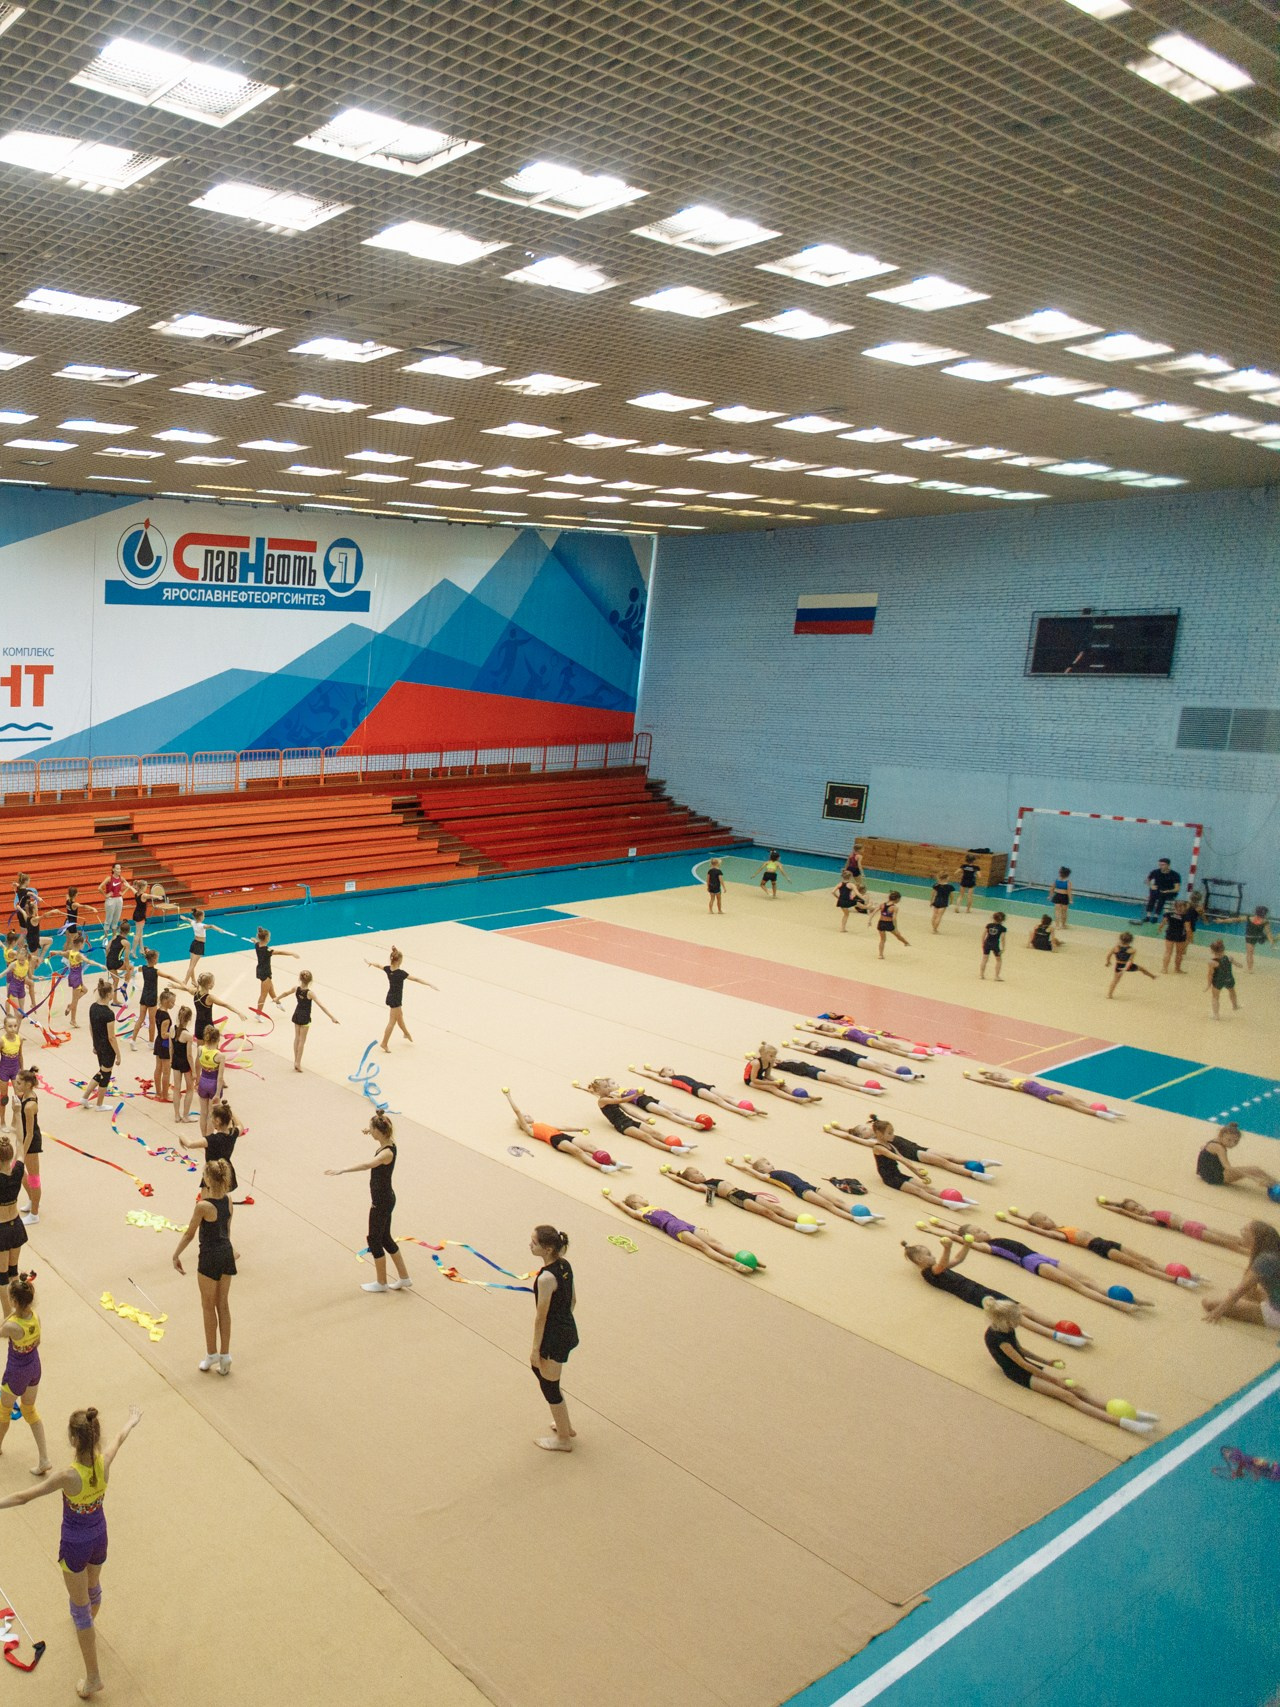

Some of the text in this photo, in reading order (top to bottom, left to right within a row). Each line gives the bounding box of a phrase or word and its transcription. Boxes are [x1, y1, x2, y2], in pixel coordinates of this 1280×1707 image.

[173, 532, 317, 587] СлавНефть
[162, 587, 326, 606] ЯРОСЛАВНЕФТЕОРГСИНТЕЗ
[2, 647, 55, 657] КОМПЛЕКС
